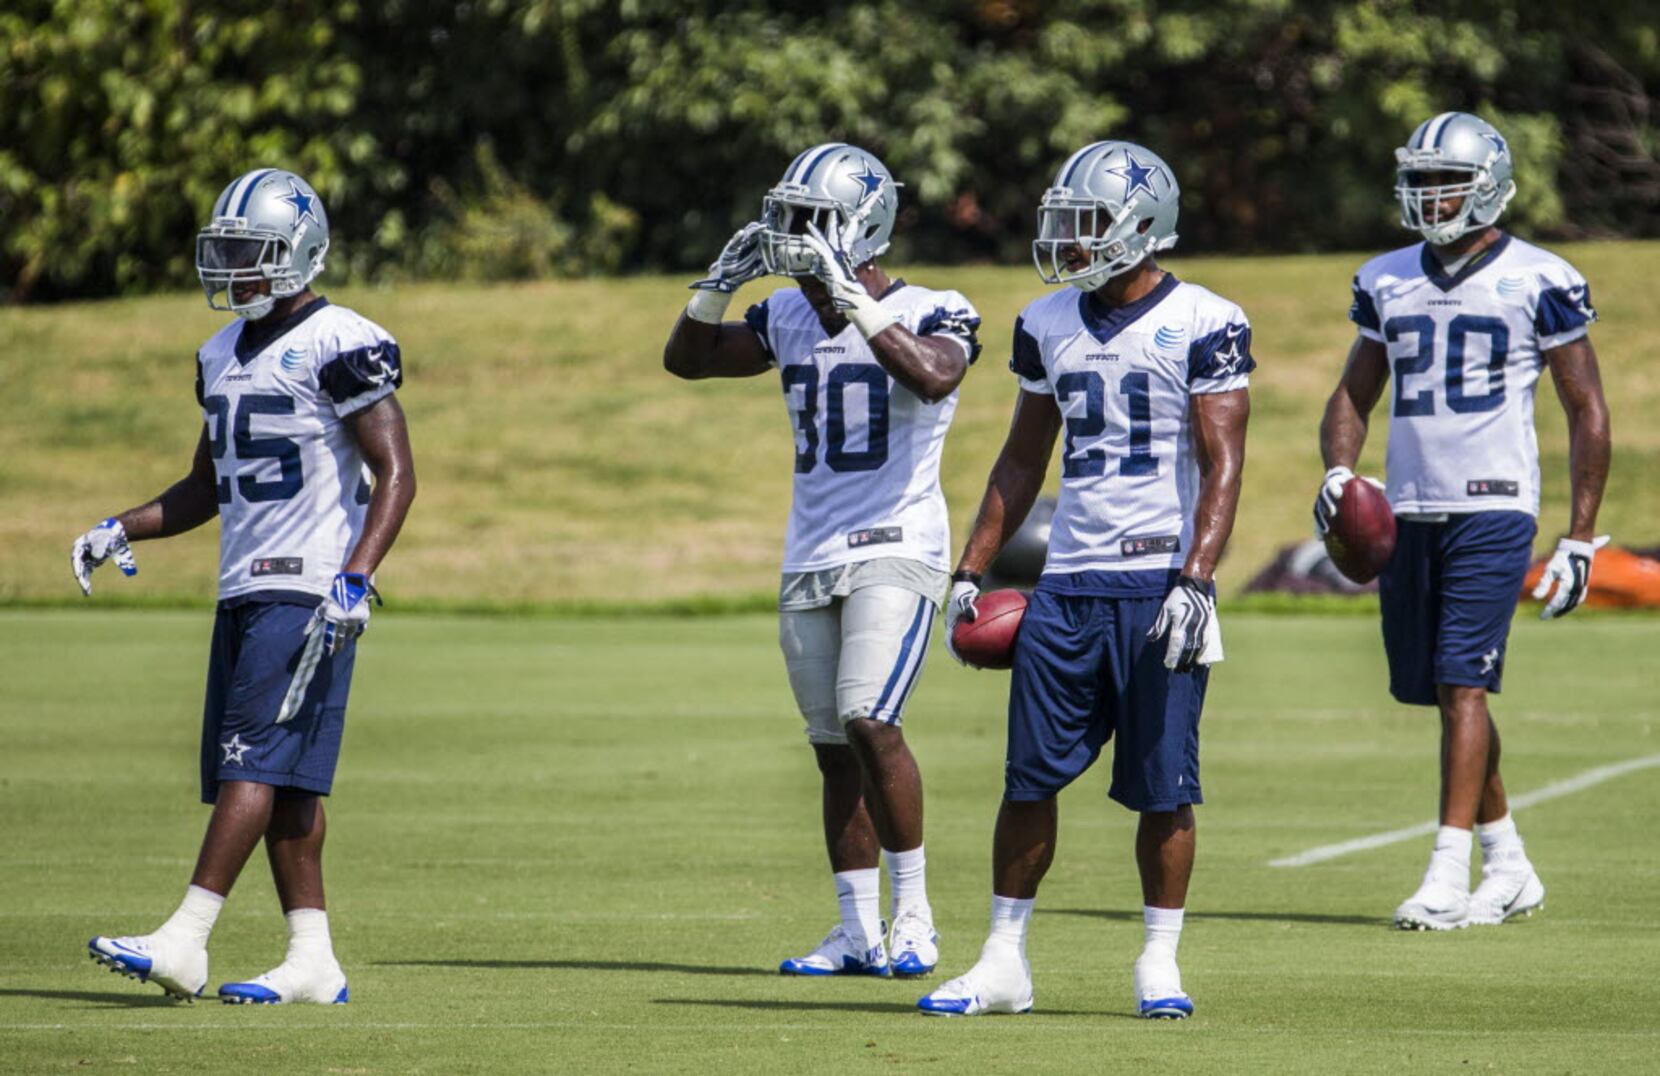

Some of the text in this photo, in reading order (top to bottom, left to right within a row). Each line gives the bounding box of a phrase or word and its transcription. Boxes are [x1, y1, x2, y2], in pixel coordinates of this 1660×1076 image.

[781, 364, 889, 474] 30
[1384, 314, 1509, 418] 20
[205, 394, 304, 504] 25
[1055, 371, 1159, 479] 21
